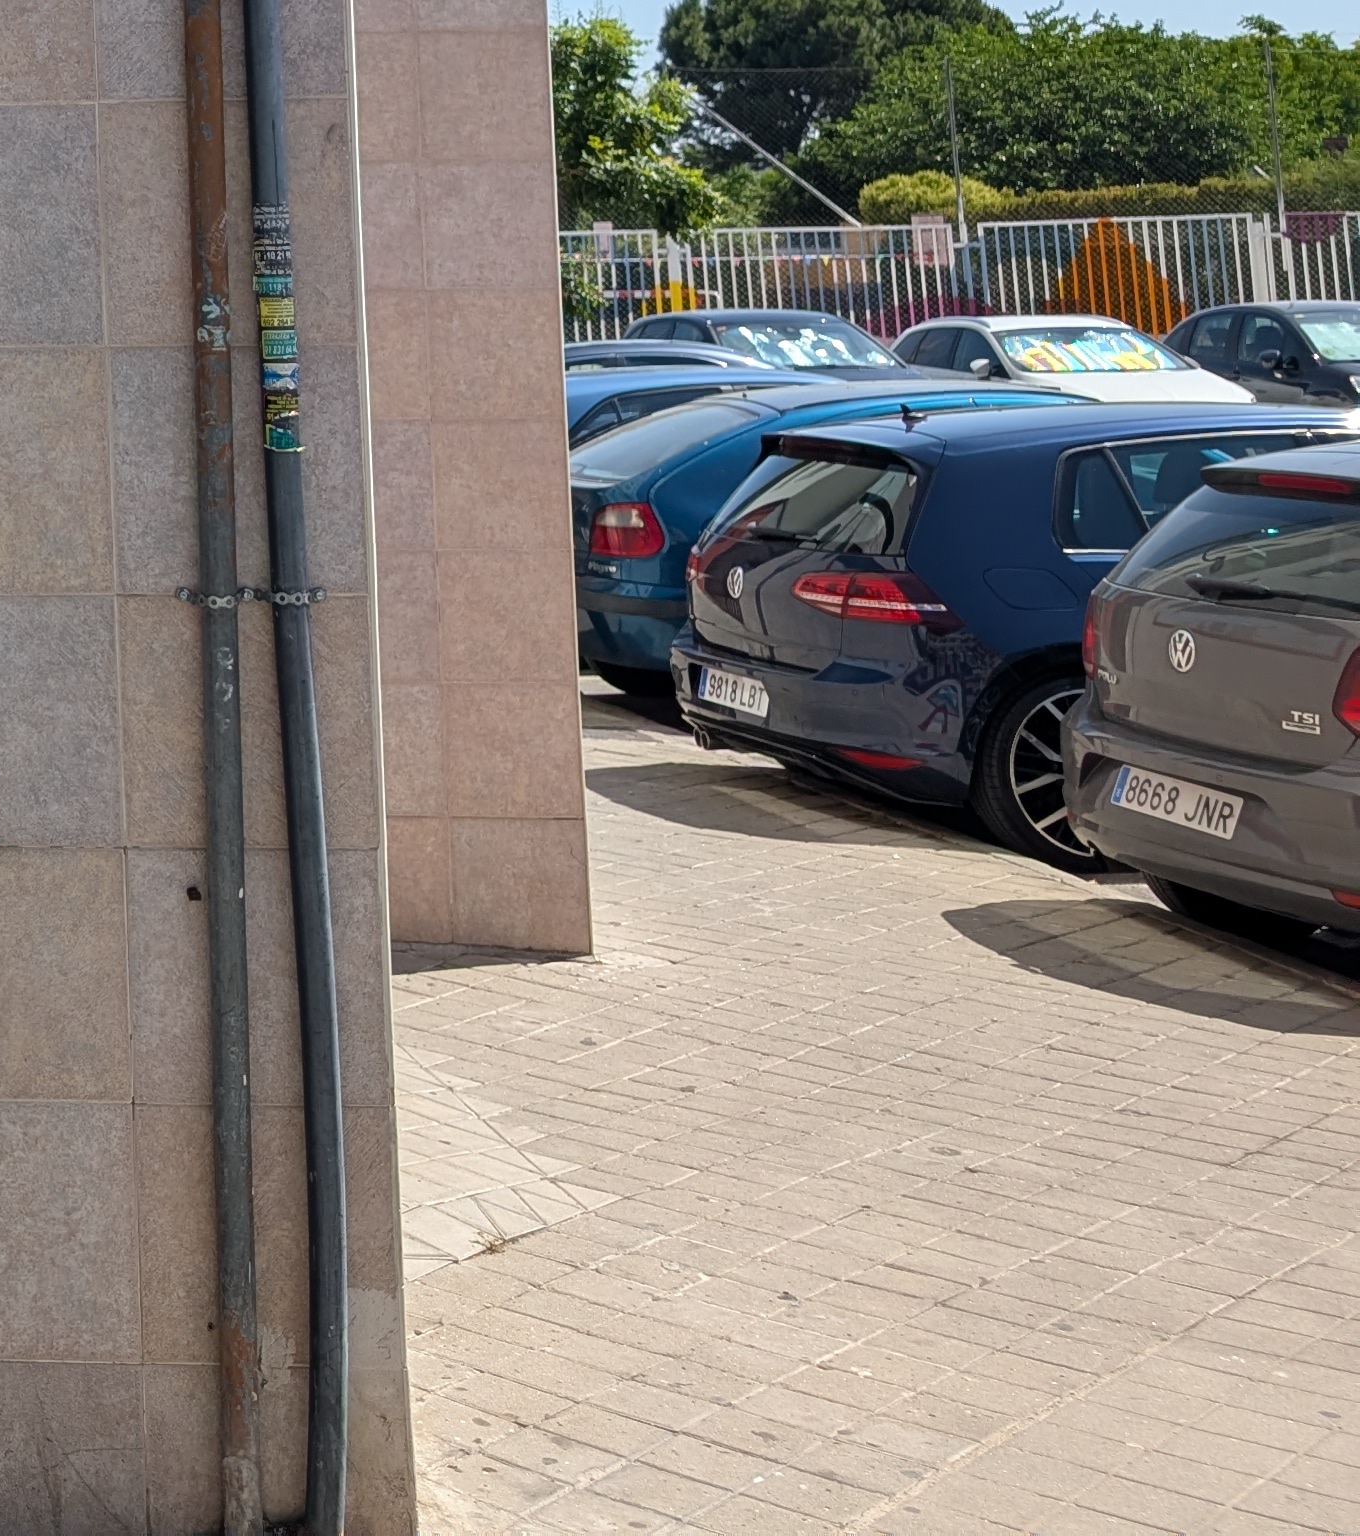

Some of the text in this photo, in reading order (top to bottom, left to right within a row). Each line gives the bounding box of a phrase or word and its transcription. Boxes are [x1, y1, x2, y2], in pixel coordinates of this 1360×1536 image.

[708, 674, 765, 711] 9818 LBT
[1291, 710, 1320, 726] TSI
[1125, 775, 1234, 834] 8668 JNR
